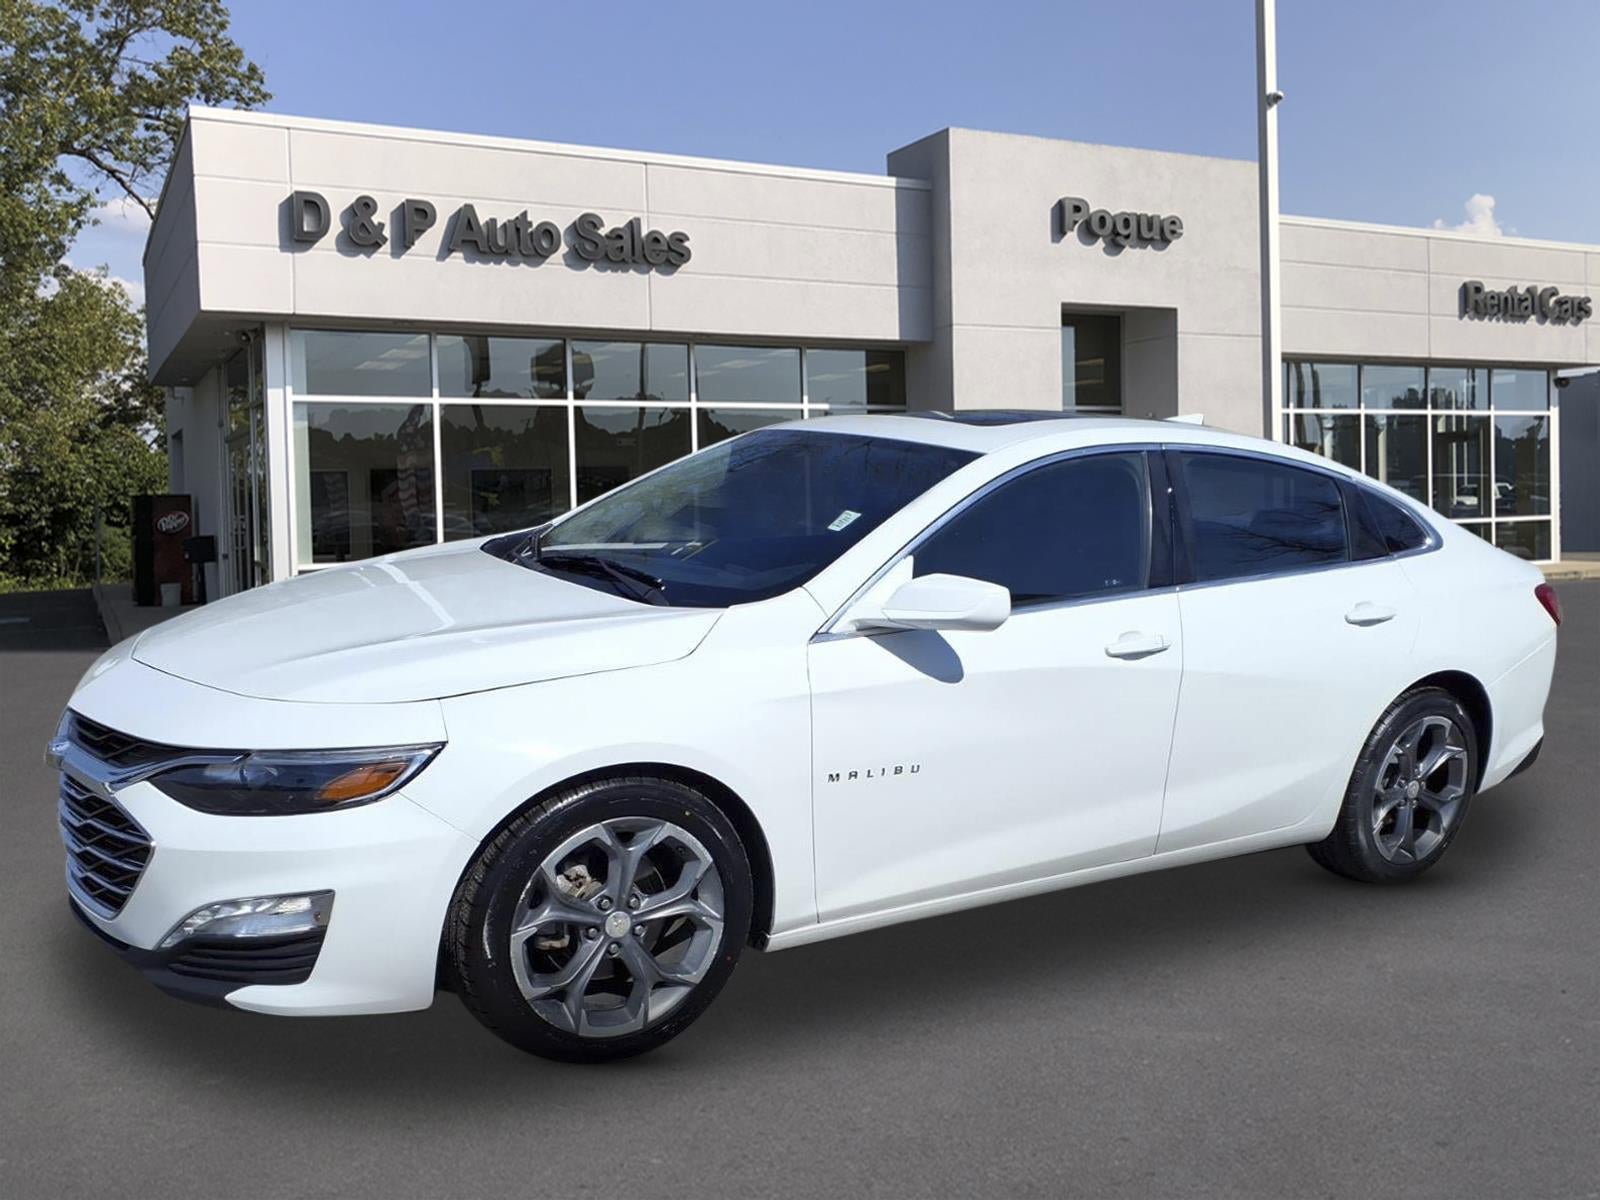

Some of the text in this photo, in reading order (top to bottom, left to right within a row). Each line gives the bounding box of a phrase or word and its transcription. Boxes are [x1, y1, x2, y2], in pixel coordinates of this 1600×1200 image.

[289, 190, 692, 269] D & P Auto Sales
[1060, 197, 1184, 250] Pogue
[1463, 280, 1592, 324] Rental Cars
[827, 764, 921, 783] MALIBU
